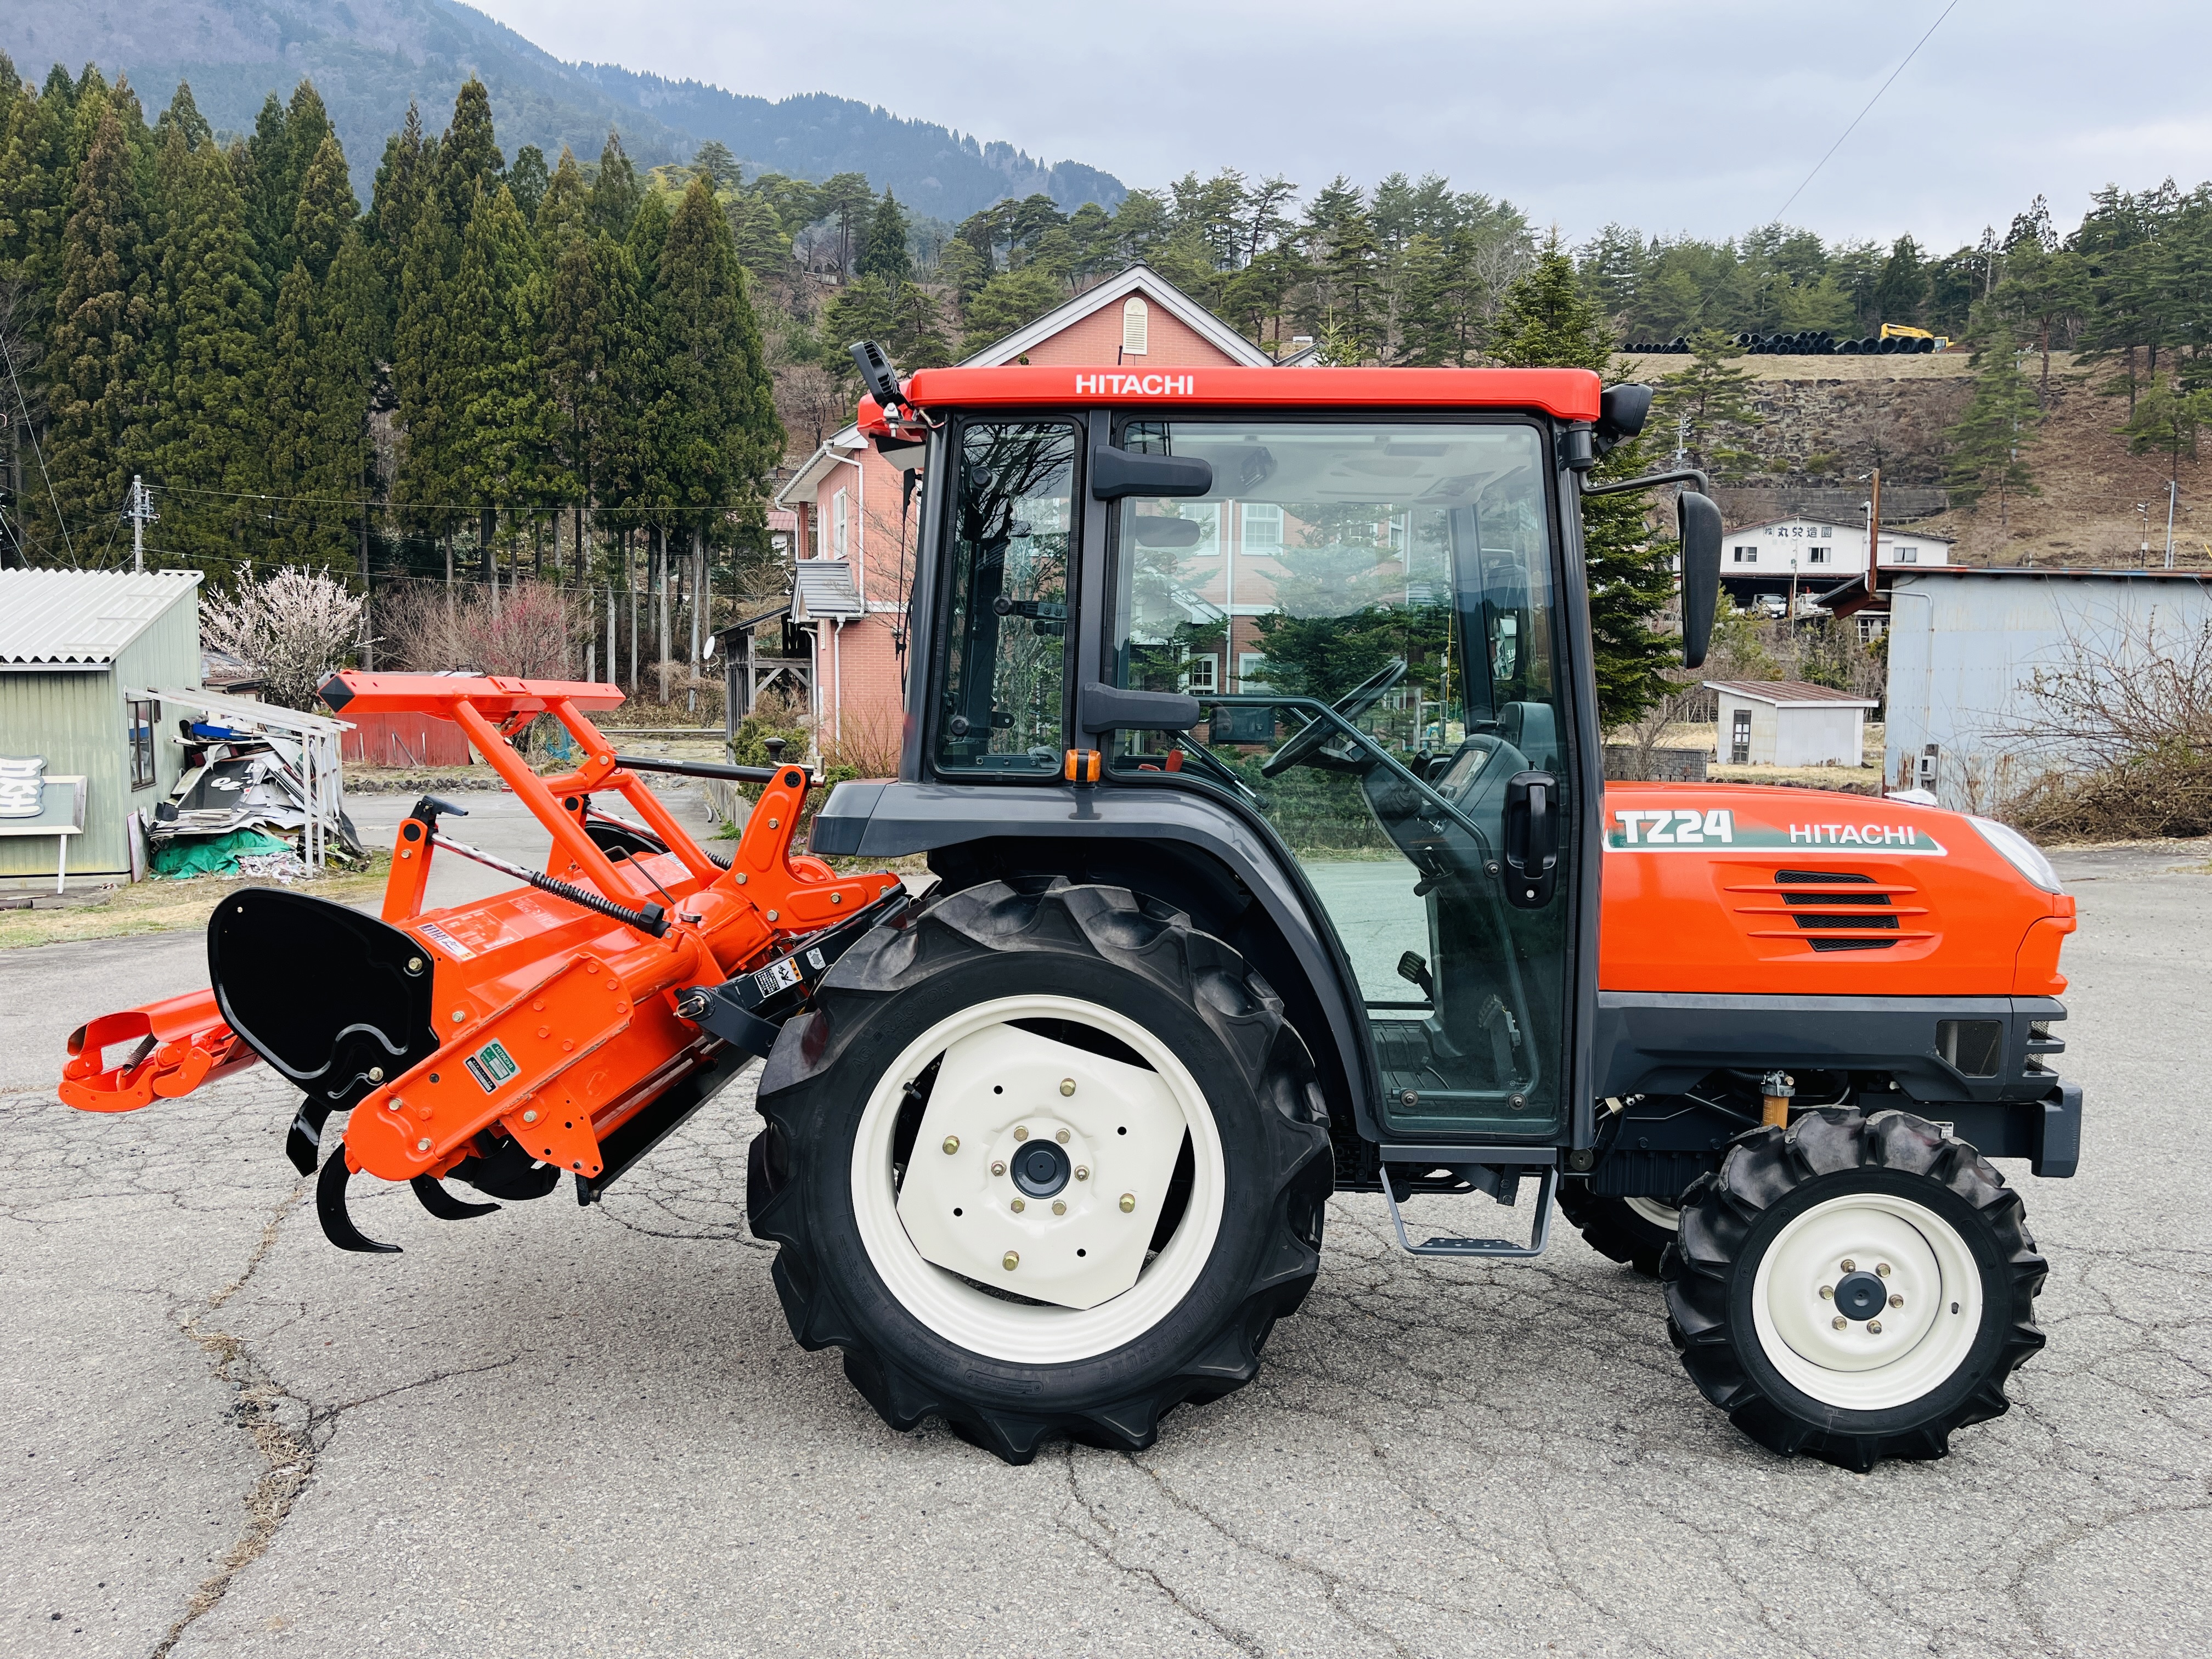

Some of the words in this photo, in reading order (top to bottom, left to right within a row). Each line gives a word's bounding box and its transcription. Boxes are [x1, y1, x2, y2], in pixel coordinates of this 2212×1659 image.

[1076, 374, 1194, 394] HITACHI
[1615, 809, 1733, 844] TZ24
[1790, 824, 1915, 845] HITACHI
[495, 1046, 514, 1068] HITACHI
